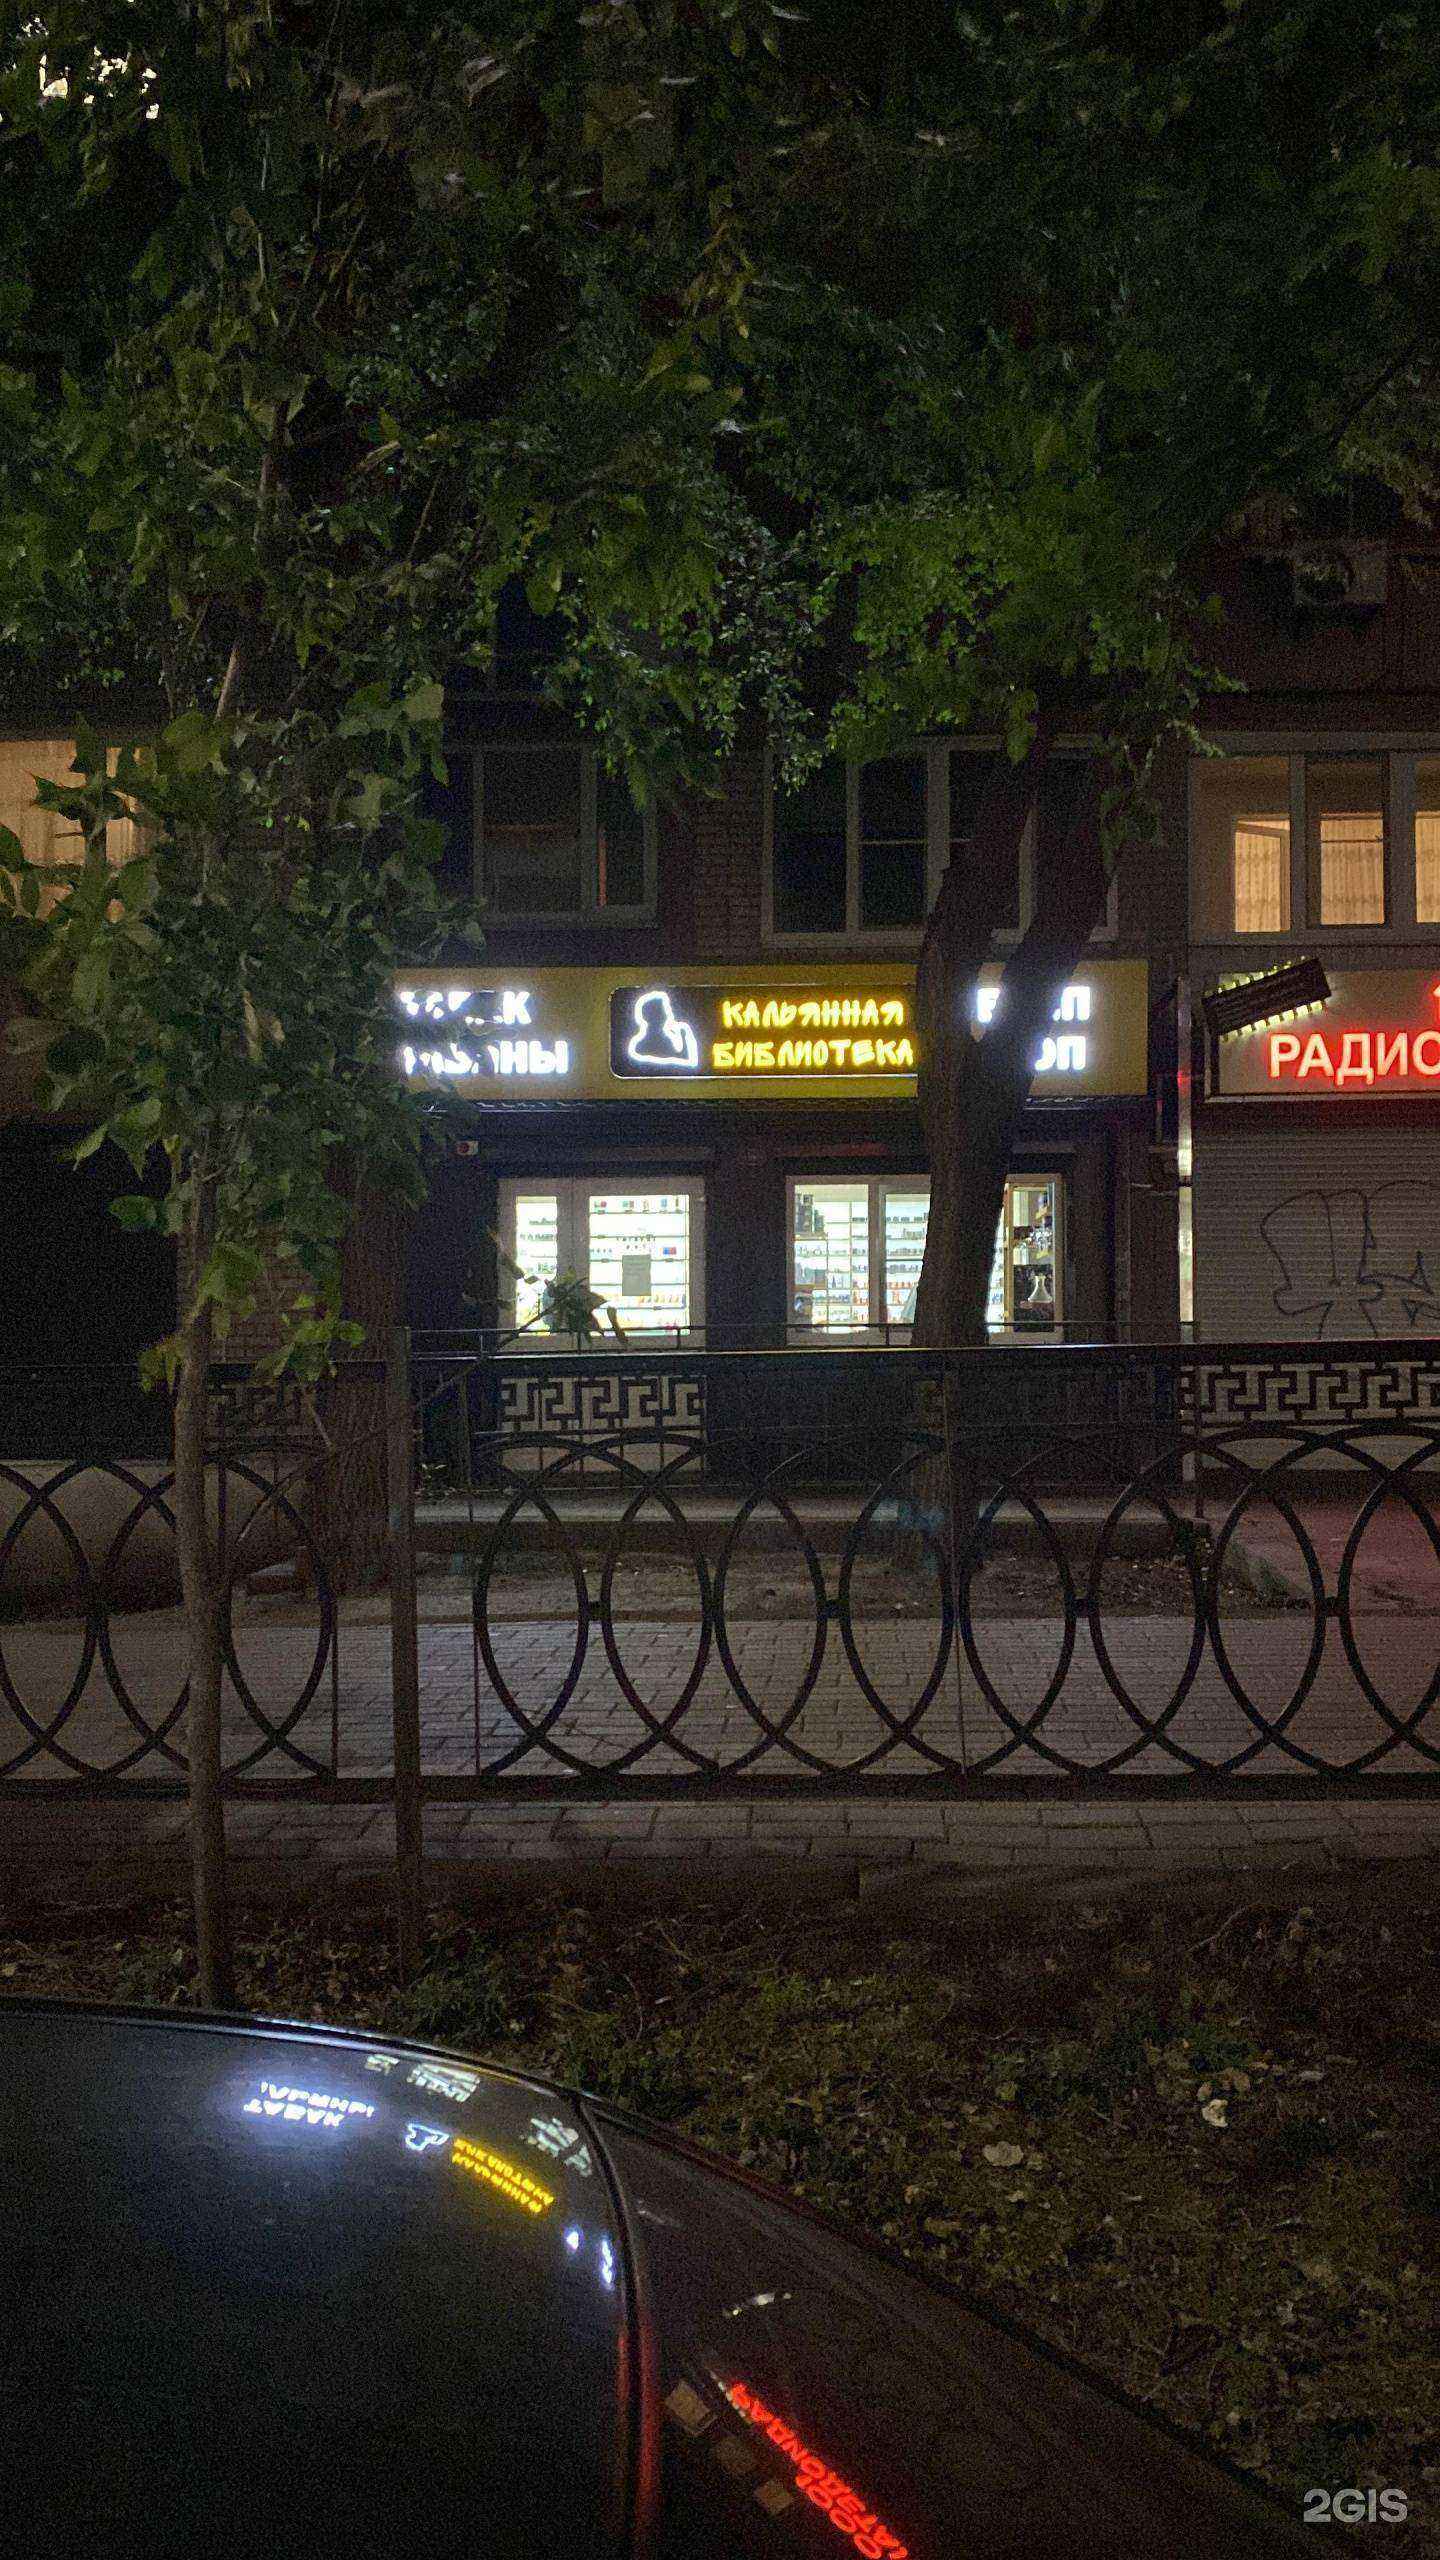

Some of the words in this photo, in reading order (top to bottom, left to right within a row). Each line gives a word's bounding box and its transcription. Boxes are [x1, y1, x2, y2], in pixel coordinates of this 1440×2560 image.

[721, 998, 905, 1029] КАЛЬЯННАЯ
[711, 1037, 915, 1068] БИБЛИОТЕКА
[1268, 1030, 1440, 1086] РАДИО
